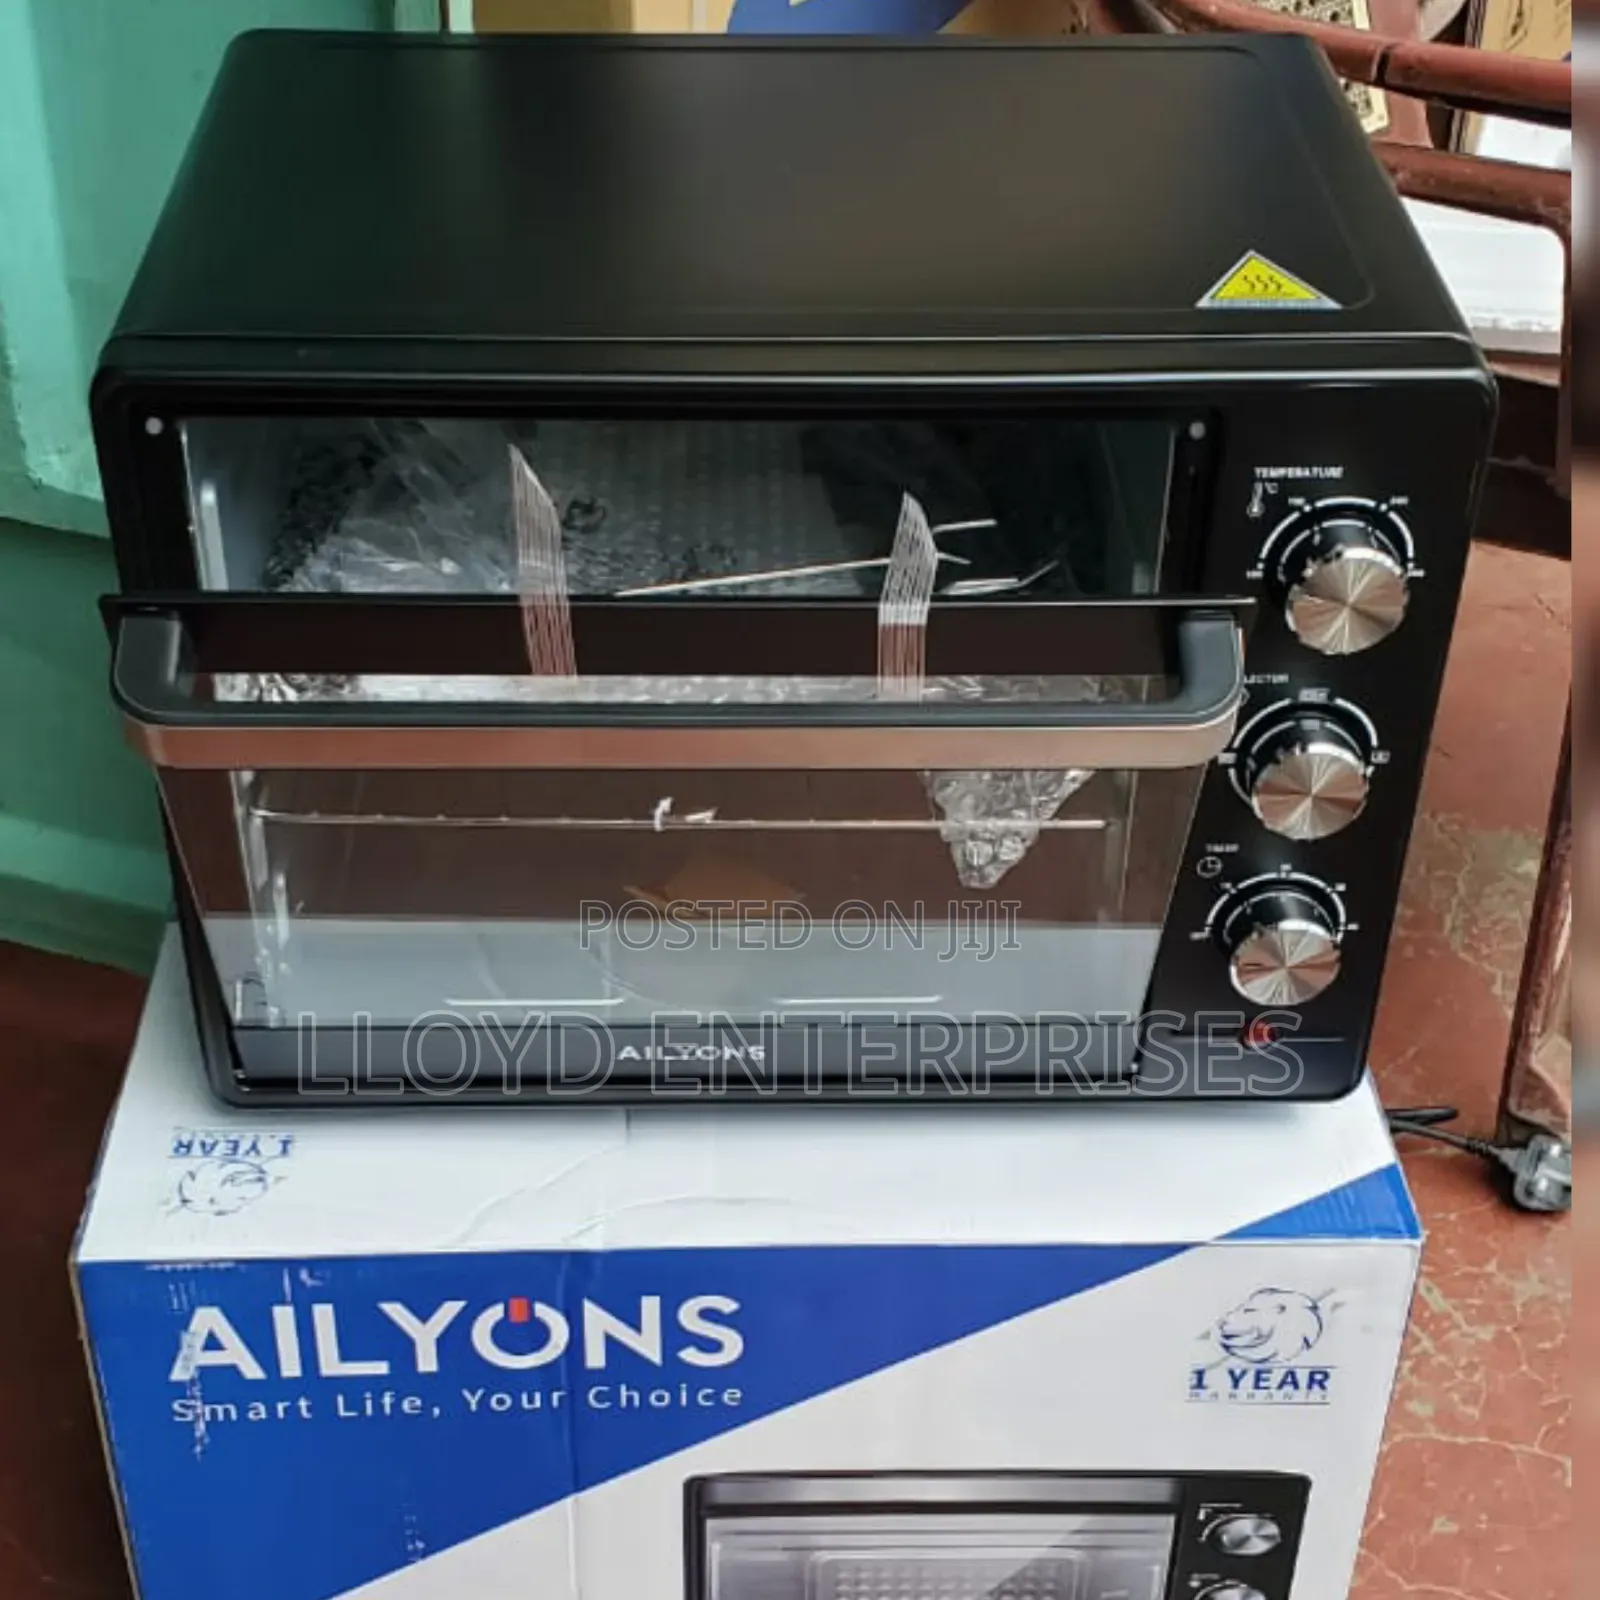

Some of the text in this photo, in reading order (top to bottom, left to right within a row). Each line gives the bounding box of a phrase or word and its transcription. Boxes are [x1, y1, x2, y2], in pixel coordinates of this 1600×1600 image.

[616, 1045, 767, 1062] AILYONS
[169, 1295, 744, 1382] AILYONS
[1189, 1368, 1331, 1391] 1 YEAR
[171, 1383, 743, 1422] Smart Life, Your Choice
